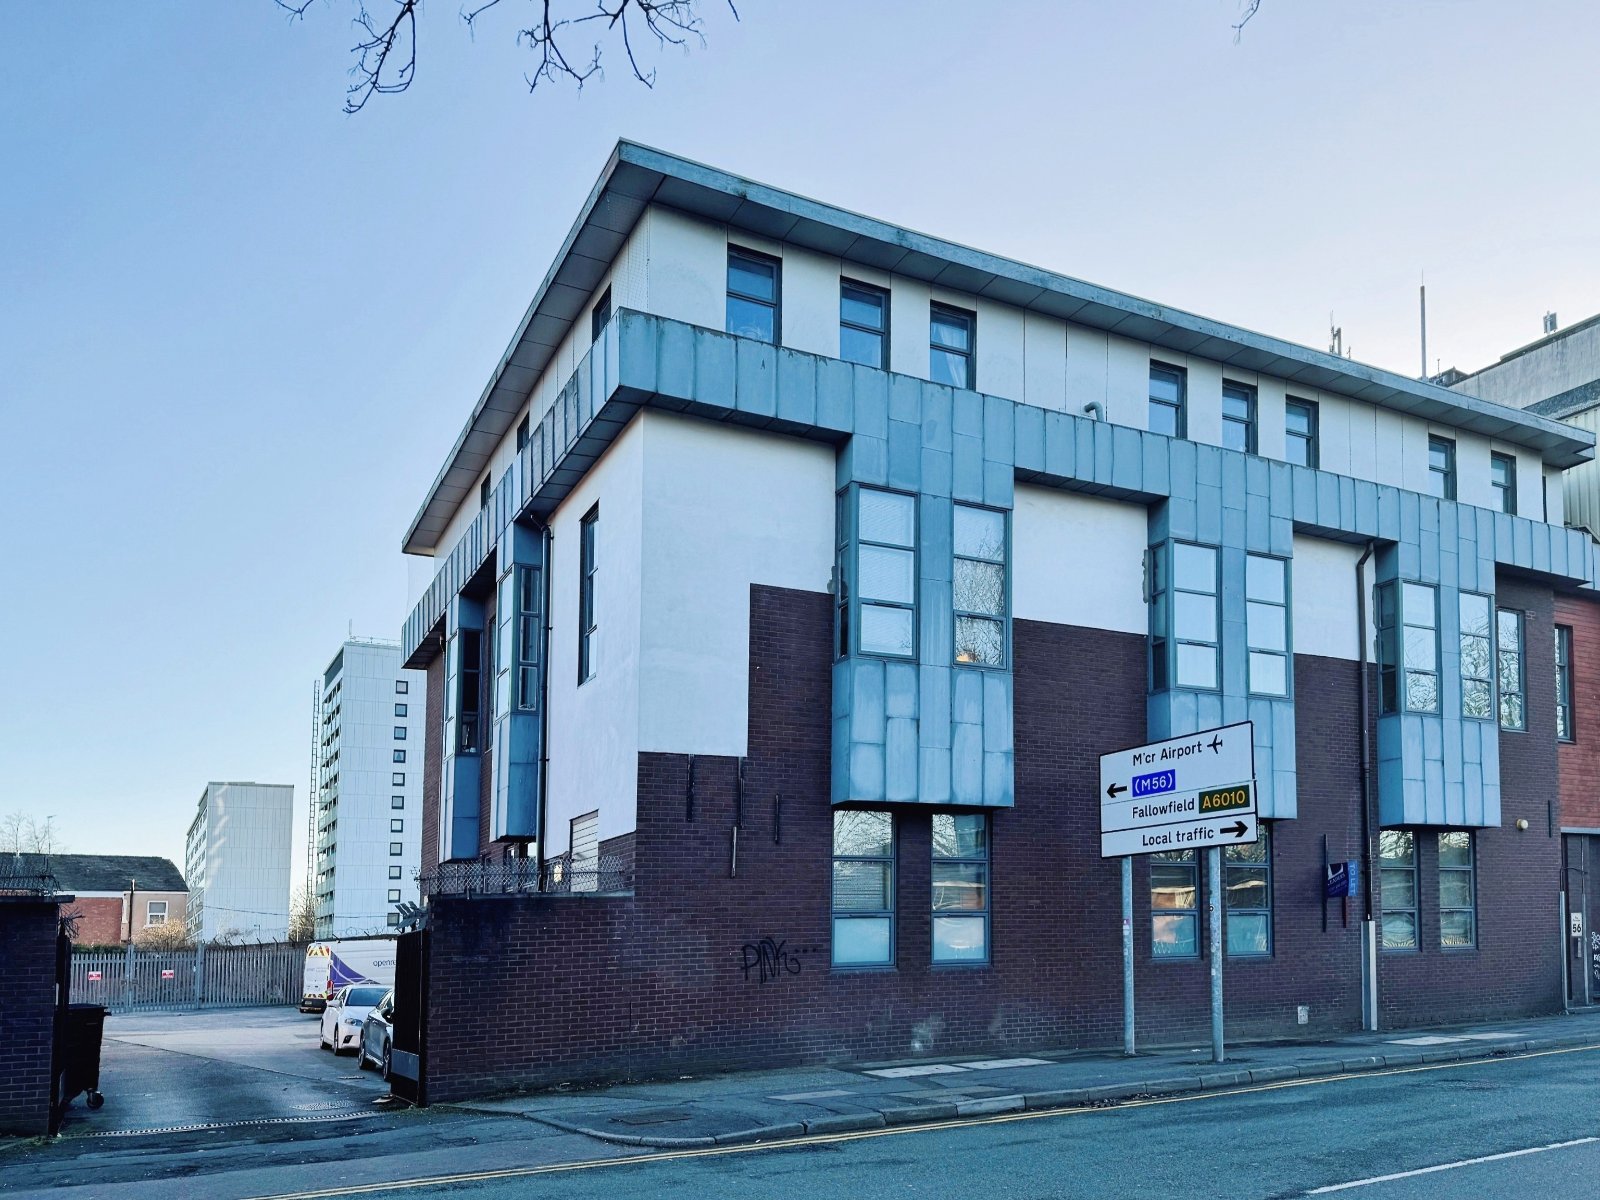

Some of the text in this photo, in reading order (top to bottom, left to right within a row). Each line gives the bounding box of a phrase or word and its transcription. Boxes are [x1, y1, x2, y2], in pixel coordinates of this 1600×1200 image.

[1133, 741, 1202, 766] M'cr Airport
[1134, 773, 1174, 793] (M56)
[1132, 790, 1246, 818] Fallowfield A6010
[1142, 827, 1214, 846] Local traffic
[1572, 923, 1582, 933] 56
